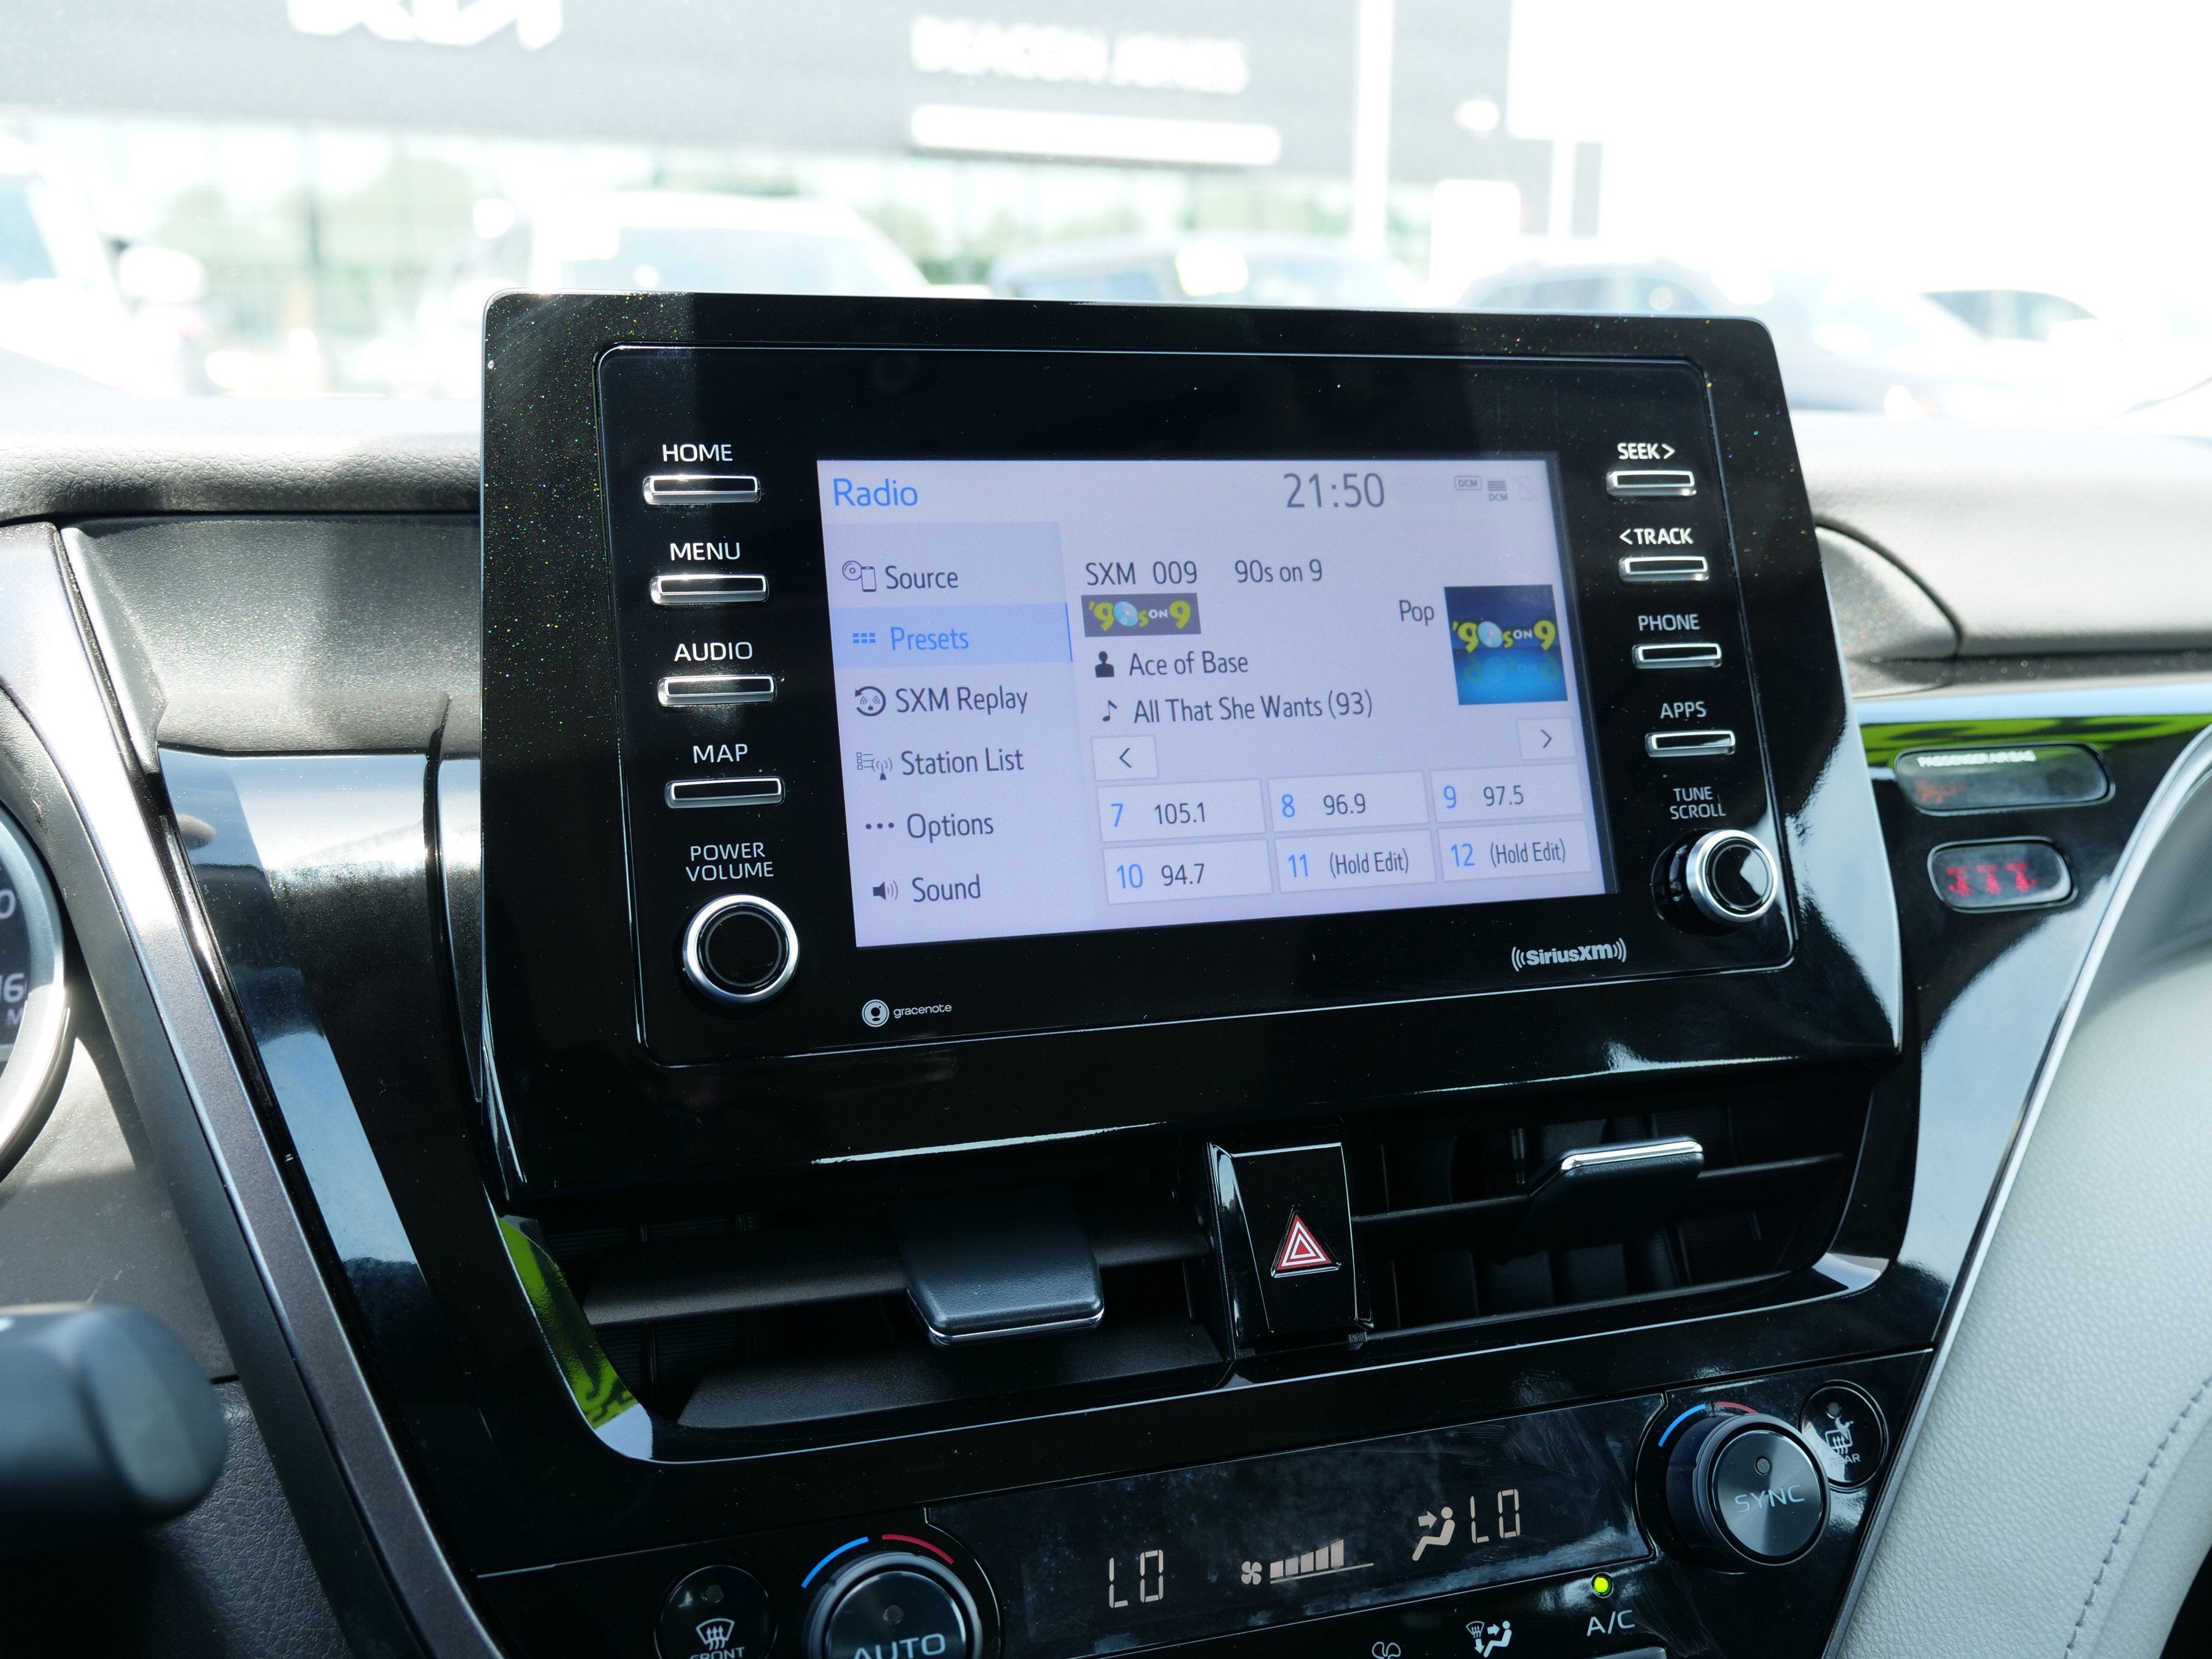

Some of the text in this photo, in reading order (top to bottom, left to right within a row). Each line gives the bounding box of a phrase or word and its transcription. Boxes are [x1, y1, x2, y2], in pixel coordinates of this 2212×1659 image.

[663, 444, 734, 462] HOME
[833, 477, 918, 507] Radio
[1284, 473, 1385, 508] 21:50
[670, 542, 741, 561] MENU
[885, 565, 959, 589] Source
[1086, 561, 1197, 585] SXM 009
[1235, 558, 1322, 583] 90s on 9
[1169, 600, 1191, 629] 9
[1399, 599, 1435, 626] Pop
[1638, 614, 1701, 631] PHONE
[890, 626, 970, 651] Presets
[1533, 619, 1557, 651] 9
[674, 642, 753, 661] AUDIO
[1129, 651, 1248, 676] Ace of Base
[896, 685, 1028, 715] SXM Replay
[1134, 689, 1373, 723] All That She Wants (93)
[1660, 701, 1707, 719] APPS
[693, 744, 748, 763] MAP
[900, 748, 1024, 775] Station List
[1281, 793, 1366, 818] 8 96.9
[1443, 785, 1524, 809] 9 97.5
[1673, 787, 1713, 803] TUNE
[1110, 802, 1206, 827] 7 105.1
[1670, 803, 1726, 820] SCROLL
[907, 813, 994, 843] Options
[691, 842, 766, 862] POWER
[1288, 847, 1409, 878] 11 (Hold Edit)
[1450, 838, 1566, 868] 12 (Hold Edit)
[686, 861, 774, 882] VOLUME
[1116, 863, 1205, 889] 10 94.7
[912, 874, 981, 903] Sound
[893, 1004, 952, 1019] gracenote
[1735, 1484, 1805, 1513] SYNC
[1470, 1489, 1521, 1544] LO
[1108, 1549, 1164, 1608] LO
[1586, 1609, 1636, 1637] A/C
[852, 1633, 946, 1659] AUTO
